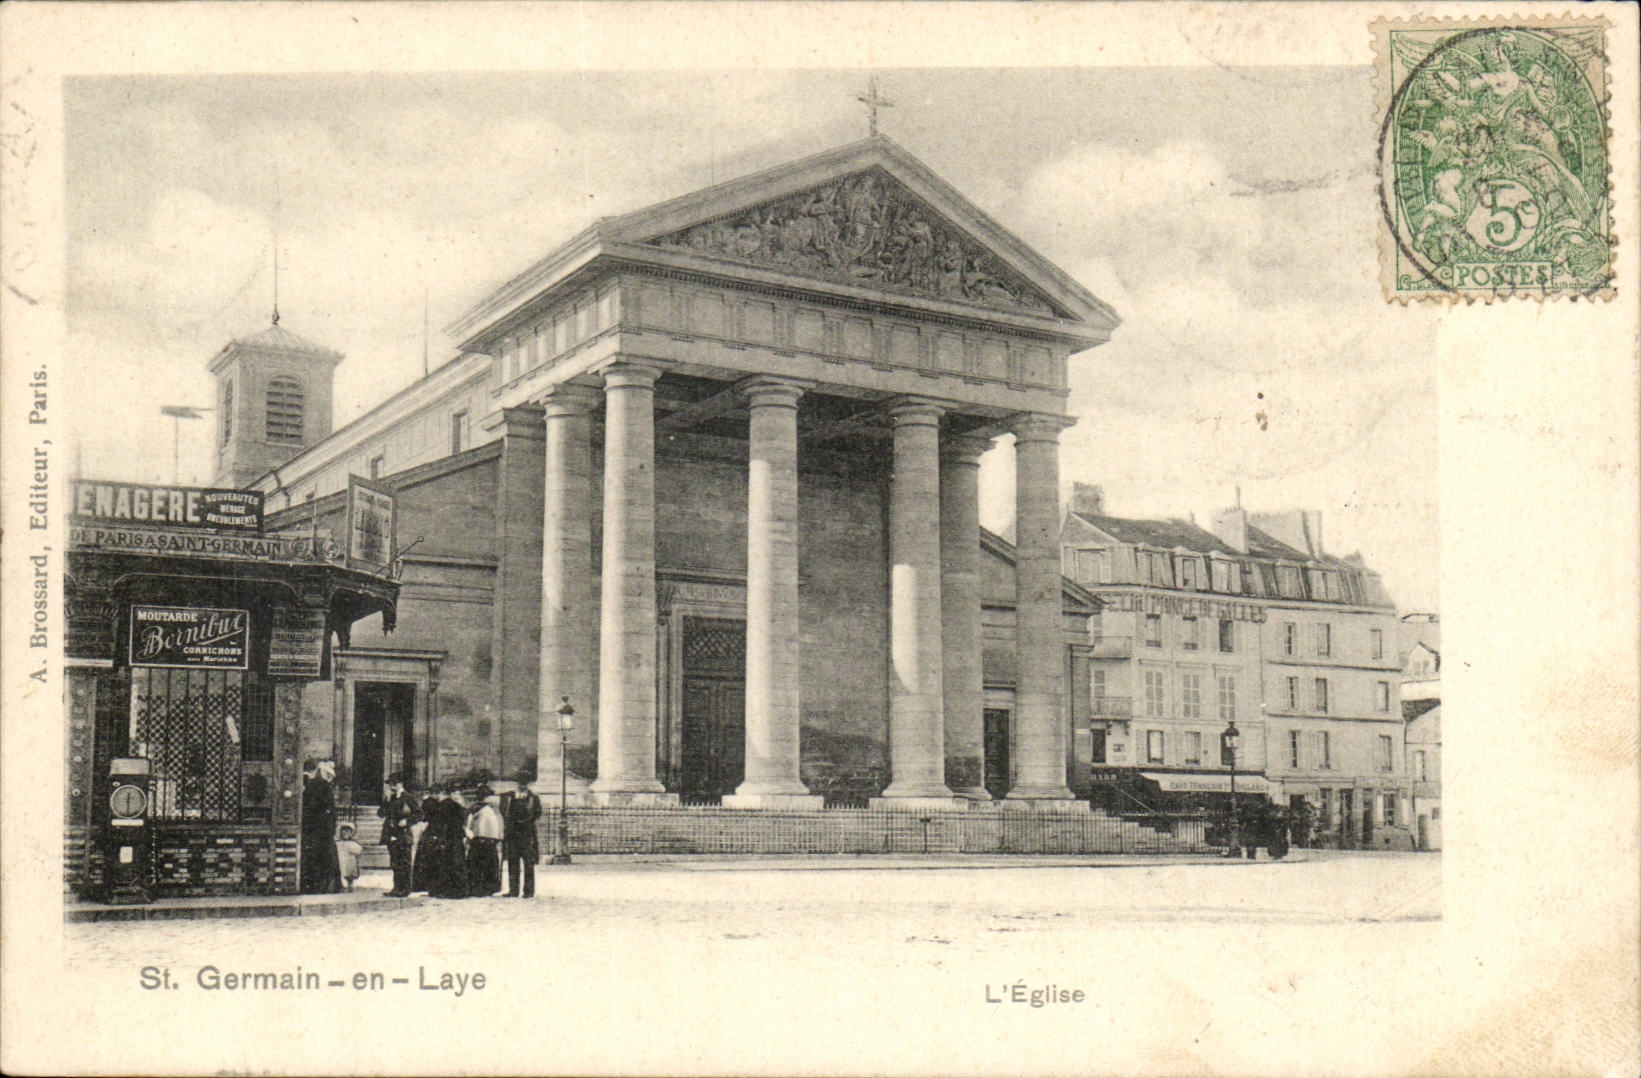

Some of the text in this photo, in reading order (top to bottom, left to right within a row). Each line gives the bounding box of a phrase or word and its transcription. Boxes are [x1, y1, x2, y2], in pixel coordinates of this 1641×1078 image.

[1457, 264, 1549, 287] POSTES
[77, 484, 201, 522] ENAGERE
[95, 529, 144, 547] PARIS
[137, 610, 198, 622] MOUTARDE
[183, 646, 242, 656] CORNICHONS
